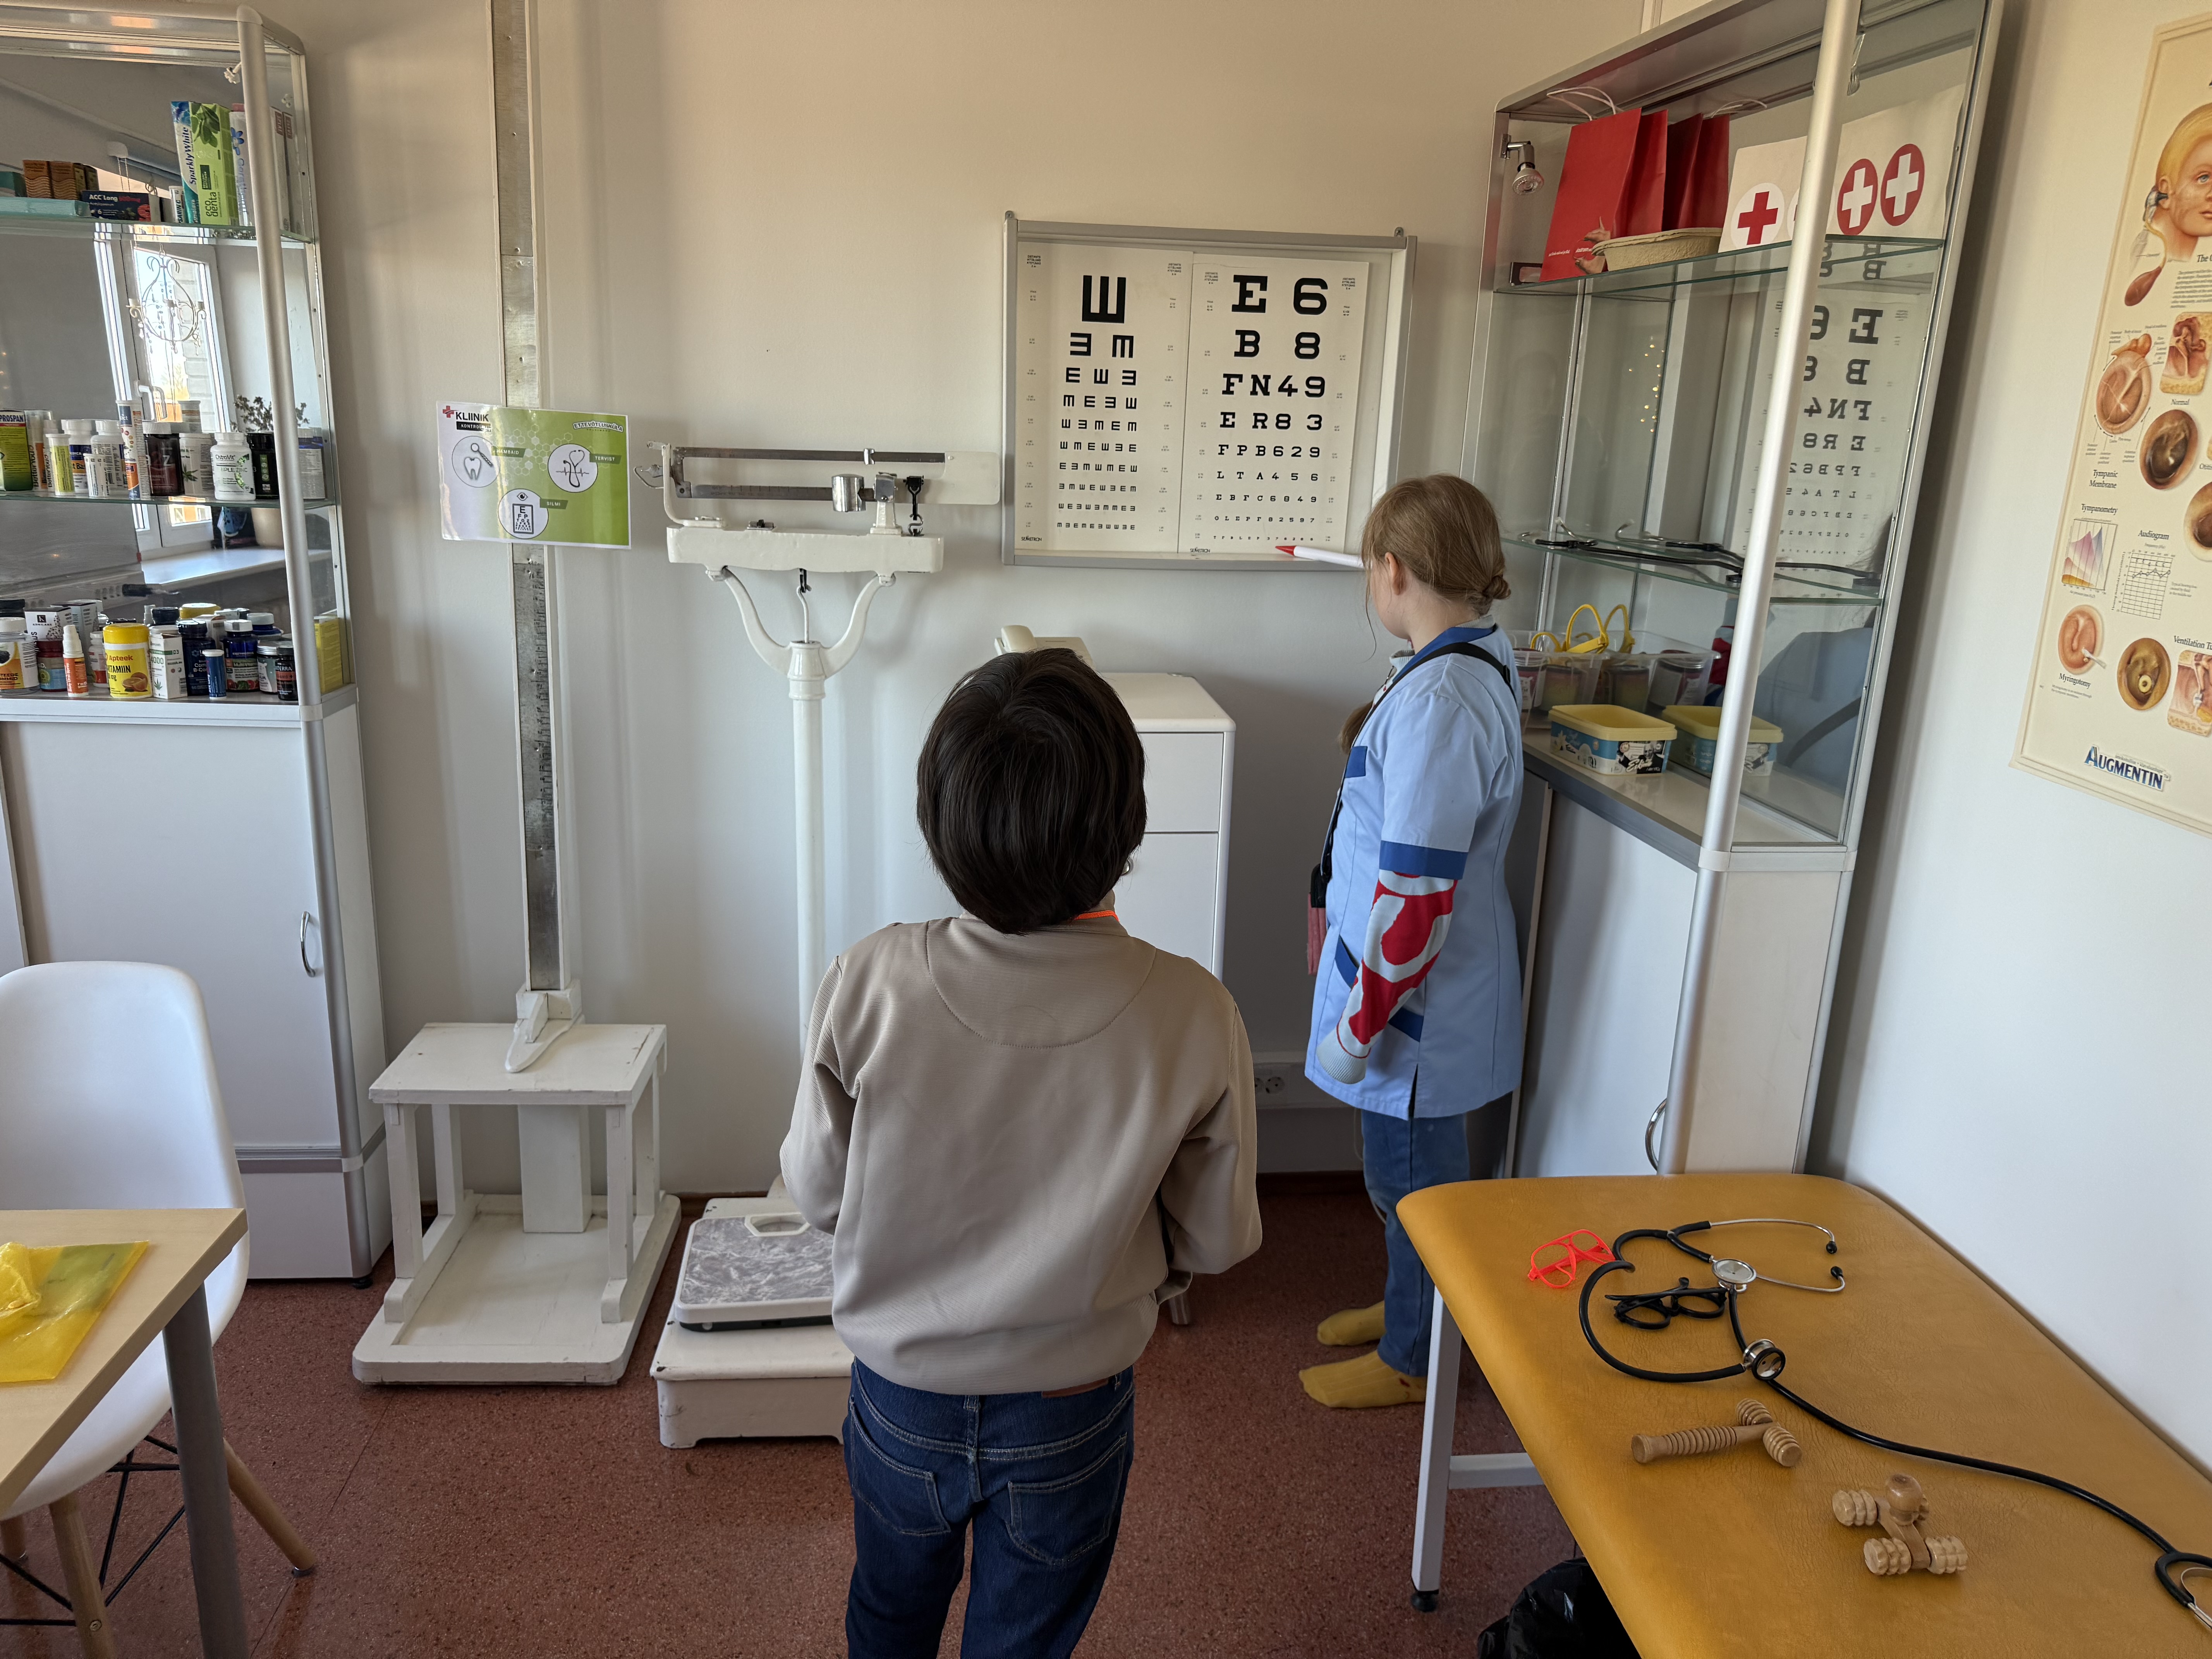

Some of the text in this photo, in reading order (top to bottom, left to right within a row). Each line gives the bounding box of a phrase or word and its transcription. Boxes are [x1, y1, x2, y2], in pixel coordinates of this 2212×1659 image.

[208, 192, 218, 217] denta
[1232, 275, 1328, 315] E 6
[1234, 330, 1320, 360] B 8
[456, 412, 489, 422] KLIINIK
[2093, 469, 2118, 479] Tympanic
[2089, 480, 2117, 488] Membrane
[2081, 503, 2118, 515] Tympanometry
[2138, 530, 2169, 540] Audiogram
[2174, 635, 2205, 649] Ventilation
[2059, 673, 2091, 689] Myringotomy
[2084, 746, 2163, 789] AUGMENTIN
